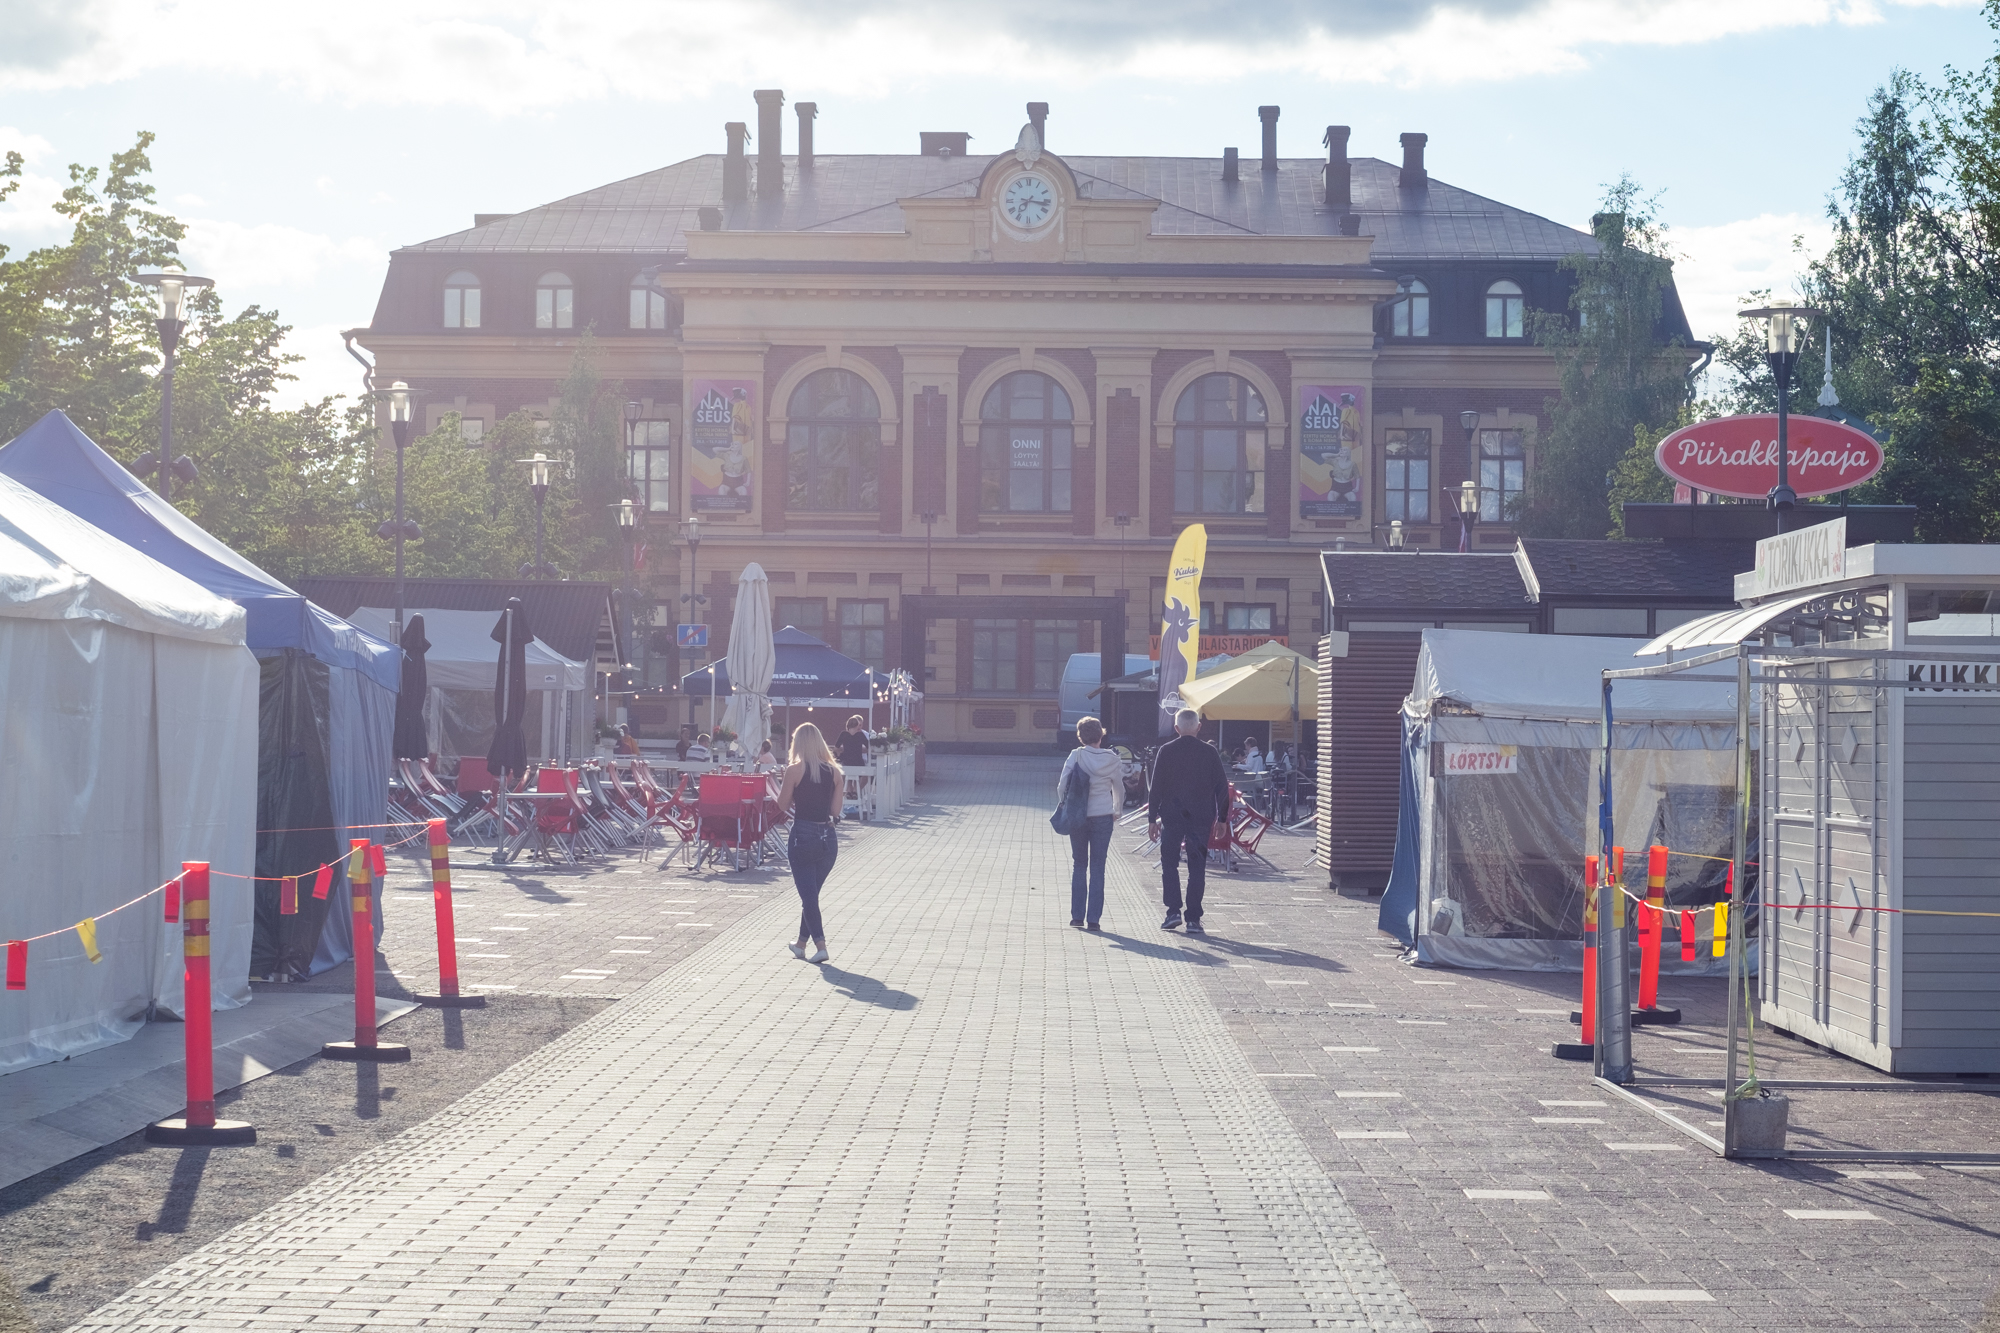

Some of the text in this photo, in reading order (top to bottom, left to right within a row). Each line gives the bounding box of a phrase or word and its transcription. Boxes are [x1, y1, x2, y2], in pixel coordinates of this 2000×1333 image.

[700, 389, 729, 410] NAI
[1308, 395, 1337, 416] NAI
[696, 410, 731, 423] SEUS
[1305, 416, 1340, 429] SEUS
[1012, 439, 1041, 448] ONNI
[1678, 439, 1870, 476] Piirakkapaja
[1767, 527, 1829, 589] TORIKUKKA
[1908, 665, 2000, 692] KUKK
